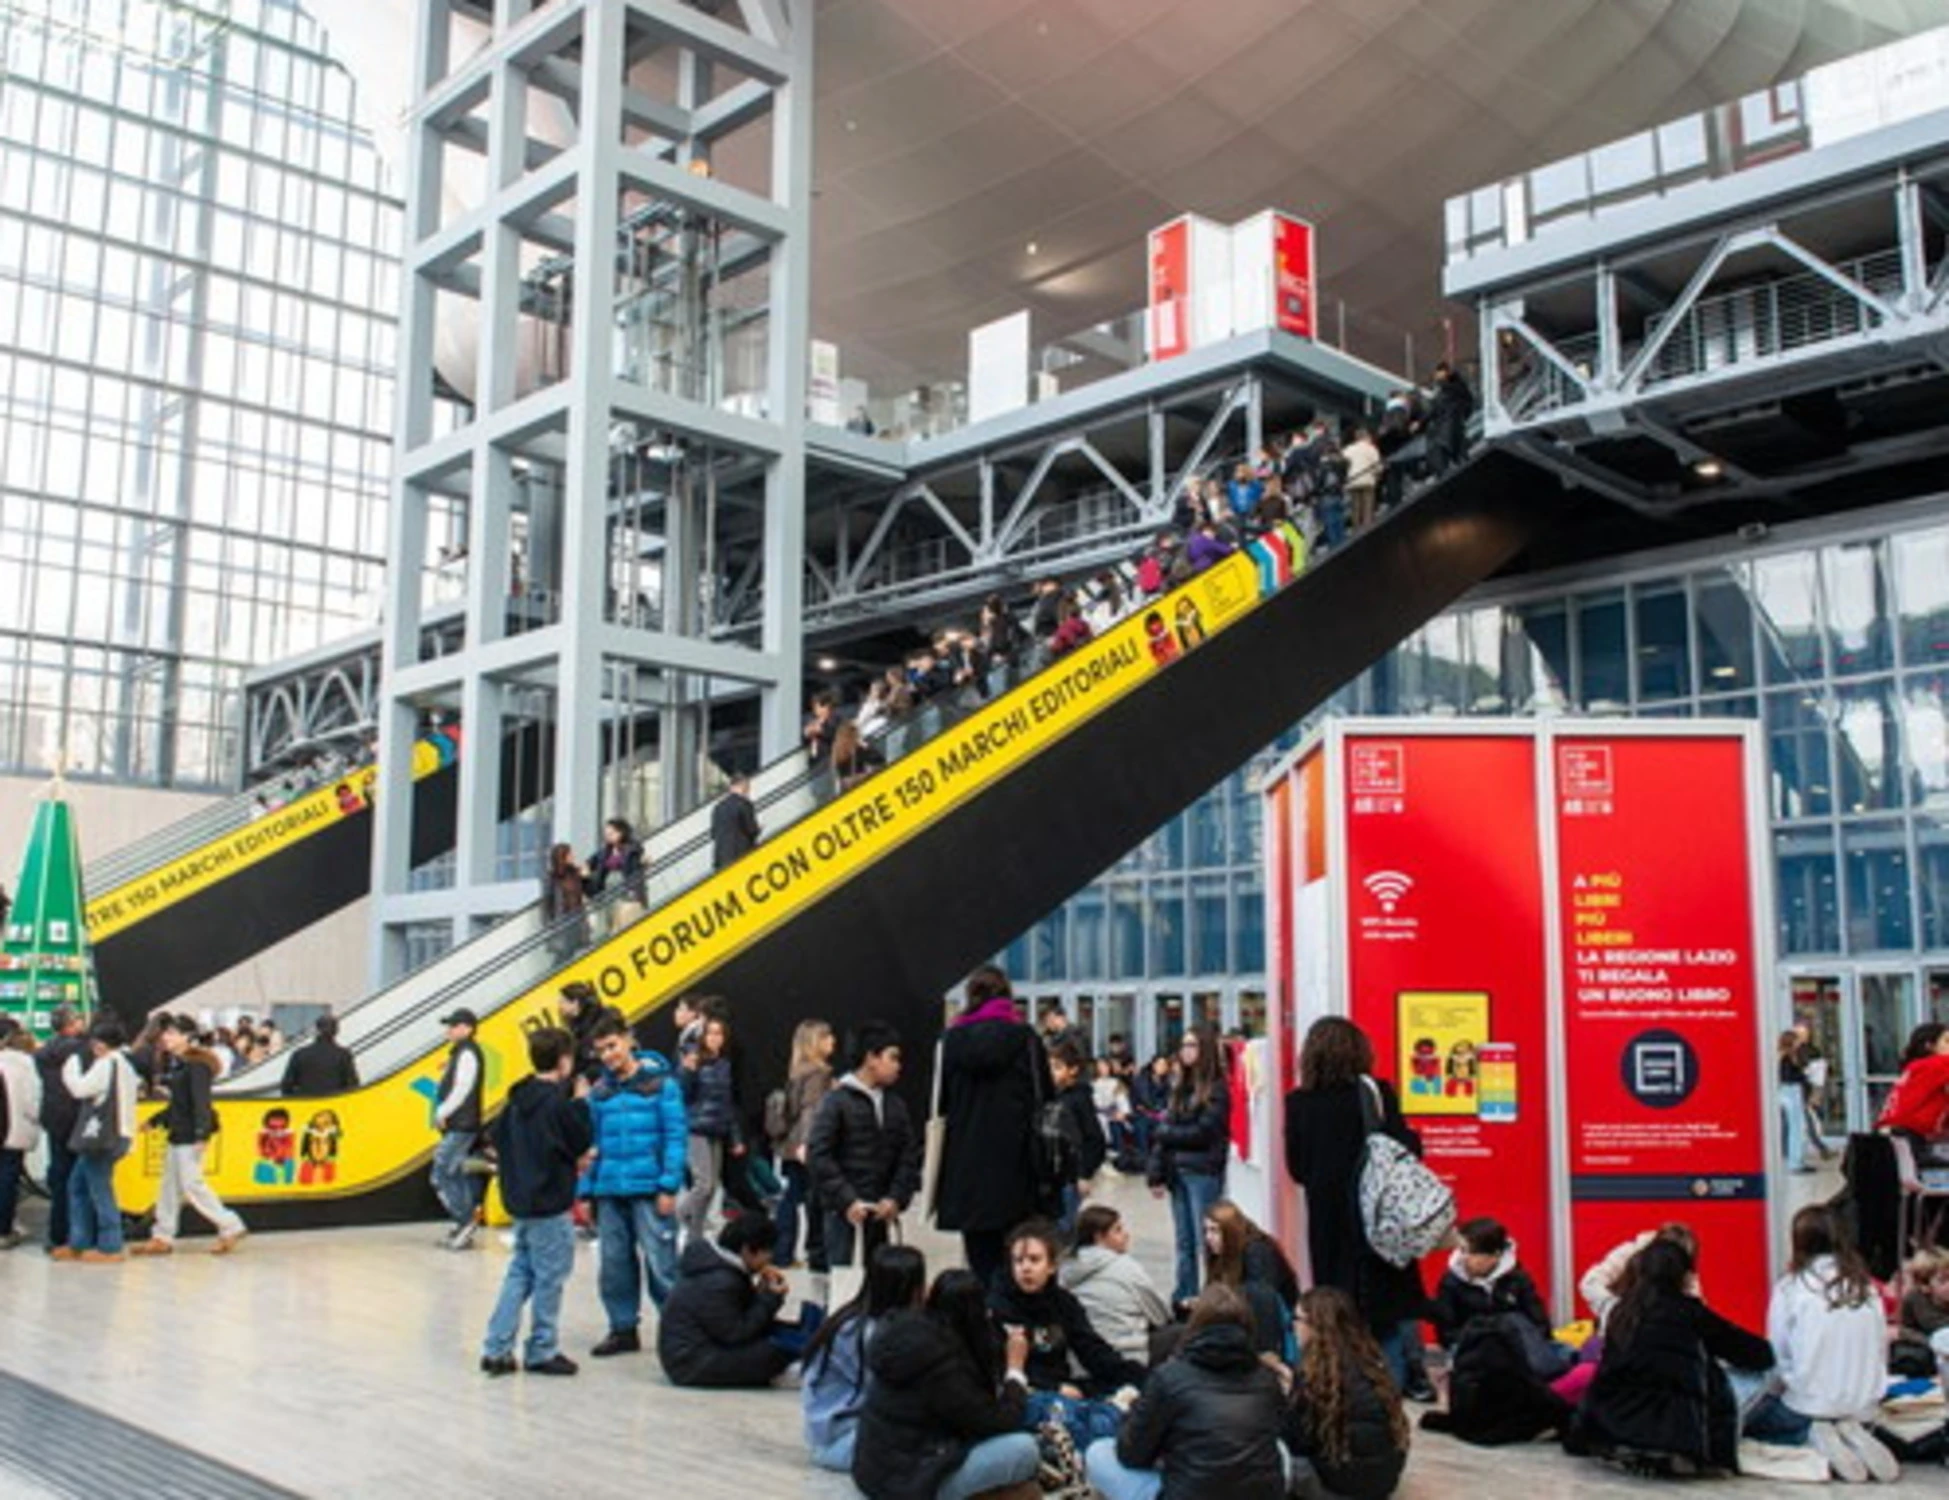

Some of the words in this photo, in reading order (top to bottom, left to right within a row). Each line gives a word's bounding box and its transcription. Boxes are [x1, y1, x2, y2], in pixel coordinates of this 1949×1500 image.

[519, 964, 627, 1036] PIO
[630, 890, 745, 980] FORUM
[745, 847, 811, 904] CON
[811, 792, 896, 861] OLTRE
[894, 768, 936, 811] 150
[936, 707, 1032, 784] MARCHI
[1028, 637, 1143, 724] EDITORIALI
[86, 901, 125, 927] TRE
[158, 849, 236, 892] MARCHI
[236, 799, 331, 857] EDITORIALI
[1573, 873, 1588, 888] A
[1577, 949, 1599, 964] LA
[1604, 949, 1680, 964] REGIONE
[1685, 949, 1738, 965] LAZIO
[1577, 969, 1595, 983] TI
[1598, 968, 1669, 983] REGALA
[1577, 988, 1605, 1002] UN
[1608, 987, 1673, 1002] BUONO
[1679, 987, 1731, 1002] LIBRO
